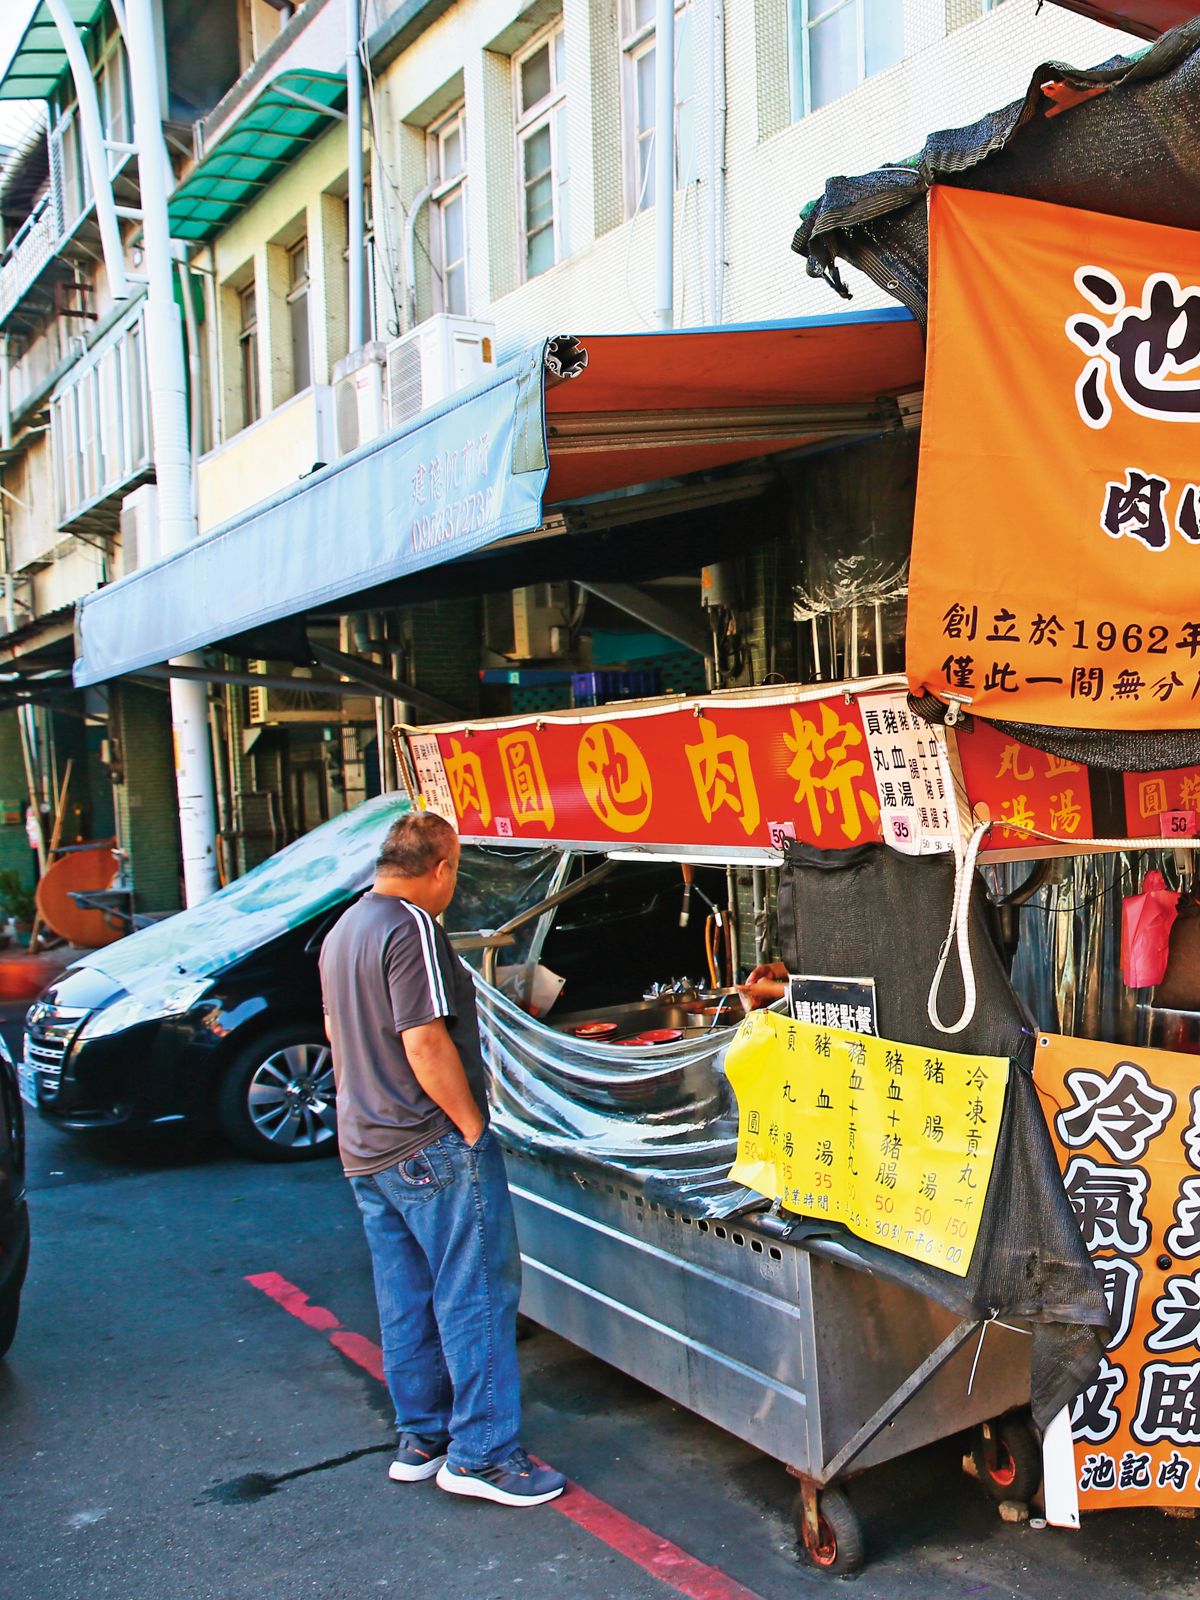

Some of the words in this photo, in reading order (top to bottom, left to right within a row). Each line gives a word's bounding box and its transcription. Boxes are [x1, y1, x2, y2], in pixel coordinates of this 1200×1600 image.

[444, 730, 556, 832] 肉圓
[685, 702, 881, 841] 肉粽
[865, 710, 897, 807] 貢丸湯
[882, 709, 915, 807] 豬血湯
[893, 821, 909, 838] 35
[1171, 816, 1187, 833] 50
[795, 1000, 873, 1034] 請排隊點餐
[782, 1025, 797, 1158] 貢丸湯
[814, 1032, 834, 1167] 豬血湯
[918, 1056, 946, 1201] 豬腸湯
[958, 1066, 989, 1189] 冷凍貢丸
[814, 1172, 833, 1189] 35
[875, 1196, 894, 1214] 50
[914, 1205, 932, 1226] 50
[944, 1216, 968, 1238] 150
